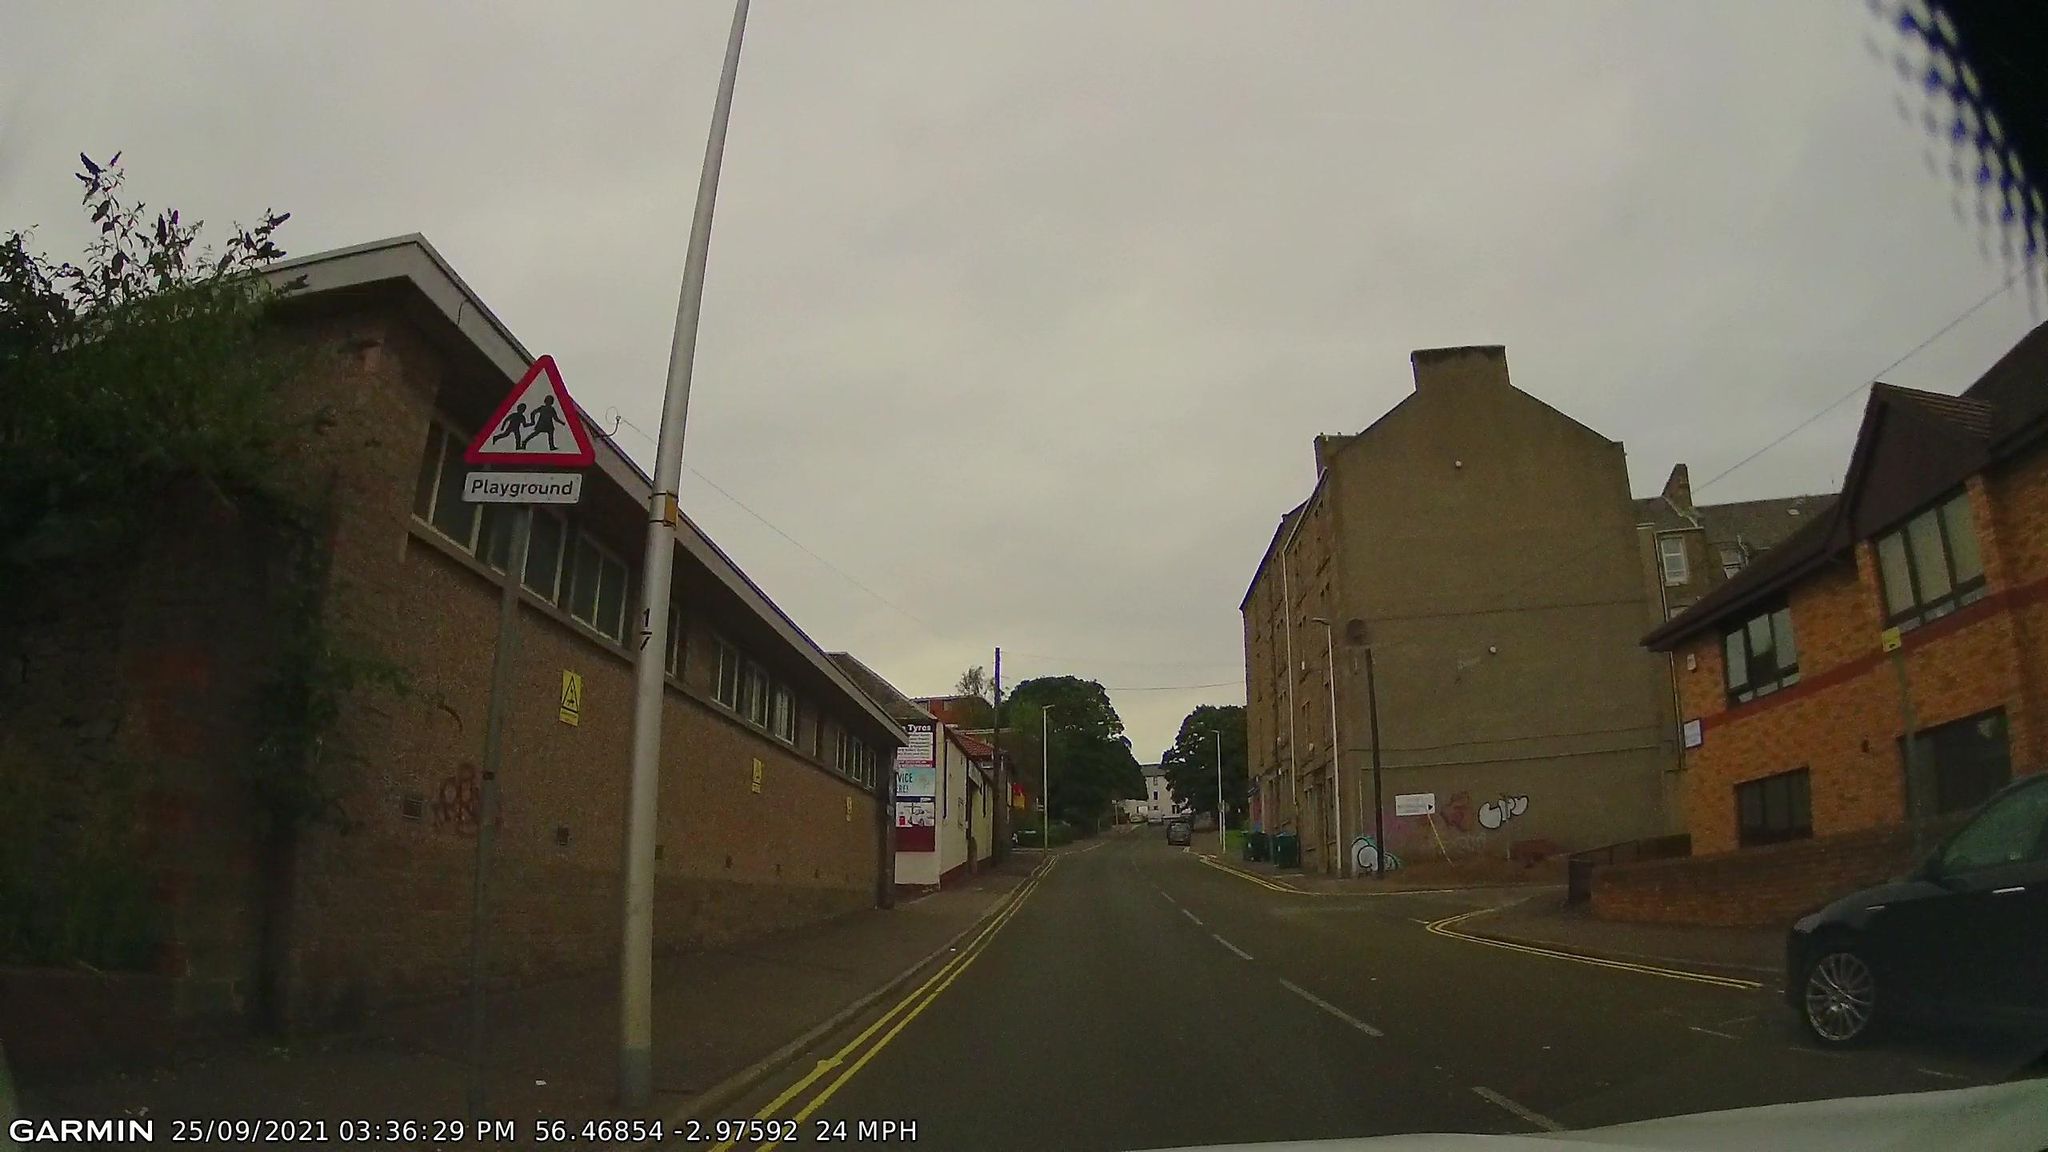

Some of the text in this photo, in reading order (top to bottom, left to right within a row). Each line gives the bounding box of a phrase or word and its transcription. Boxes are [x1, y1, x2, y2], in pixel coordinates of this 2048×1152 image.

[471, 479, 573, 498] Playground
[907, 724, 931, 733] Tyres
[897, 772, 913, 783] VICE
